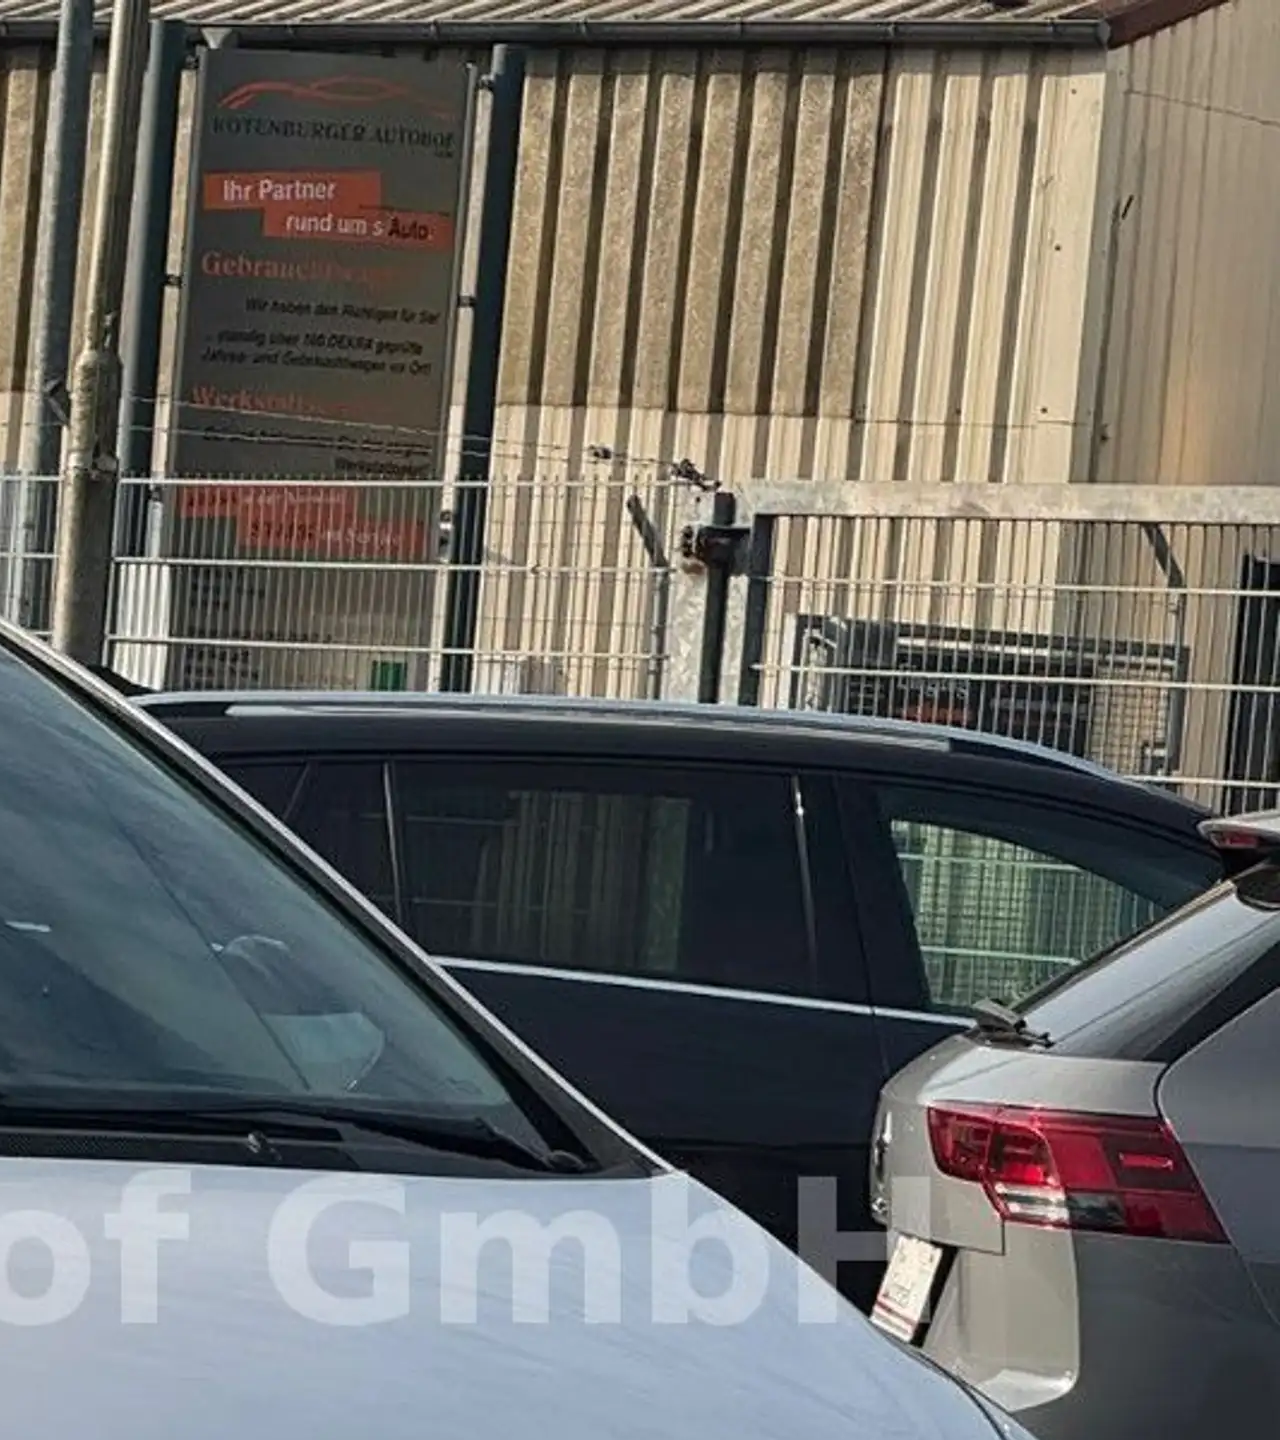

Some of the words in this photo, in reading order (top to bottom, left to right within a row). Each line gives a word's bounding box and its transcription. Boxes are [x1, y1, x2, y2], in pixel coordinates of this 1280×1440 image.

[223, 179, 252, 201] Ihr
[258, 178, 338, 201] Partner
[286, 213, 333, 233] rund
[338, 218, 368, 234] um
